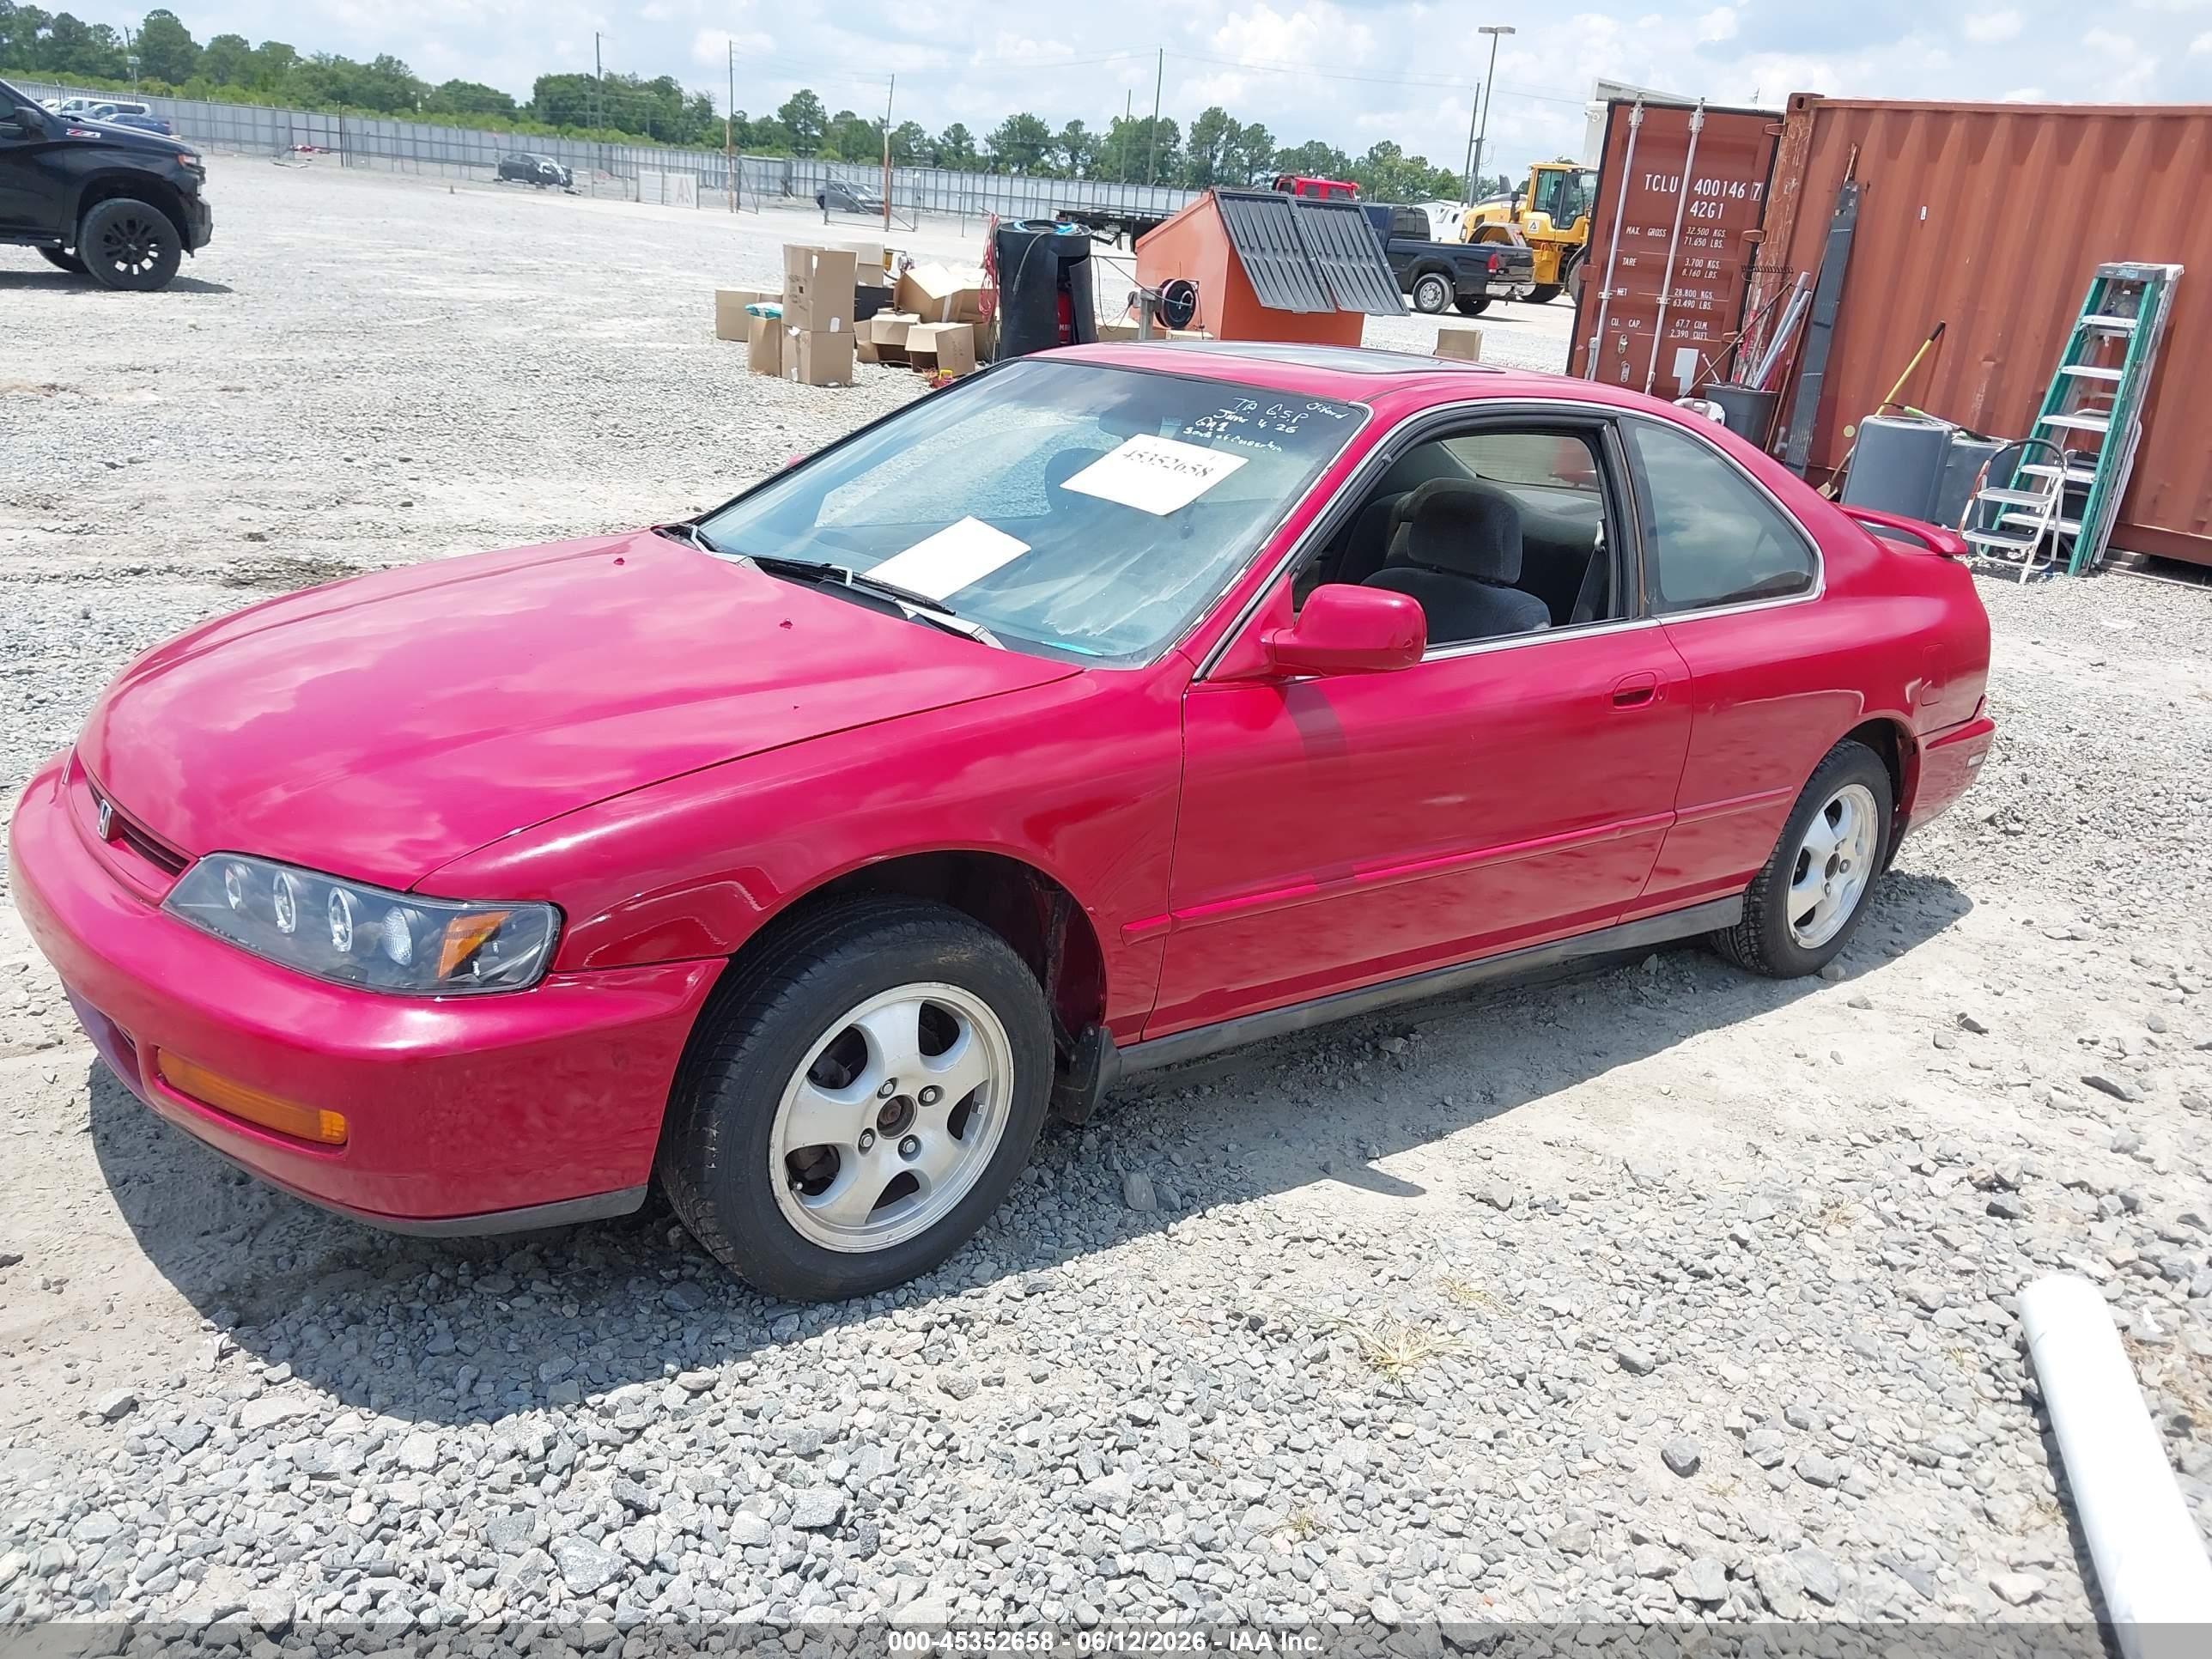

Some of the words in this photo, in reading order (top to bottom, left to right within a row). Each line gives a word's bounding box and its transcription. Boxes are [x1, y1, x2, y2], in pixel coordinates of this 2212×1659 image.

[1644, 173, 1679, 193] TCLU
[1693, 178, 1747, 199] 400146
[1752, 183, 1762, 200] 7
[1689, 200, 1724, 220] 42G1
[1647, 228, 1668, 238] GROSS
[1710, 239, 1724, 249] LBS.
[1622, 258, 1638, 267] TARE
[1685, 259, 1704, 268] 3.700
[1704, 270, 1717, 280] LBS.
[1616, 288, 1627, 296] NET
[1698, 301, 1713, 311] LBS.
[1611, 318, 1620, 326] CU.
[1628, 319, 1641, 329] CAP.
[1675, 319, 1691, 328] 67.7
[1257, 418, 1268, 429] 4
